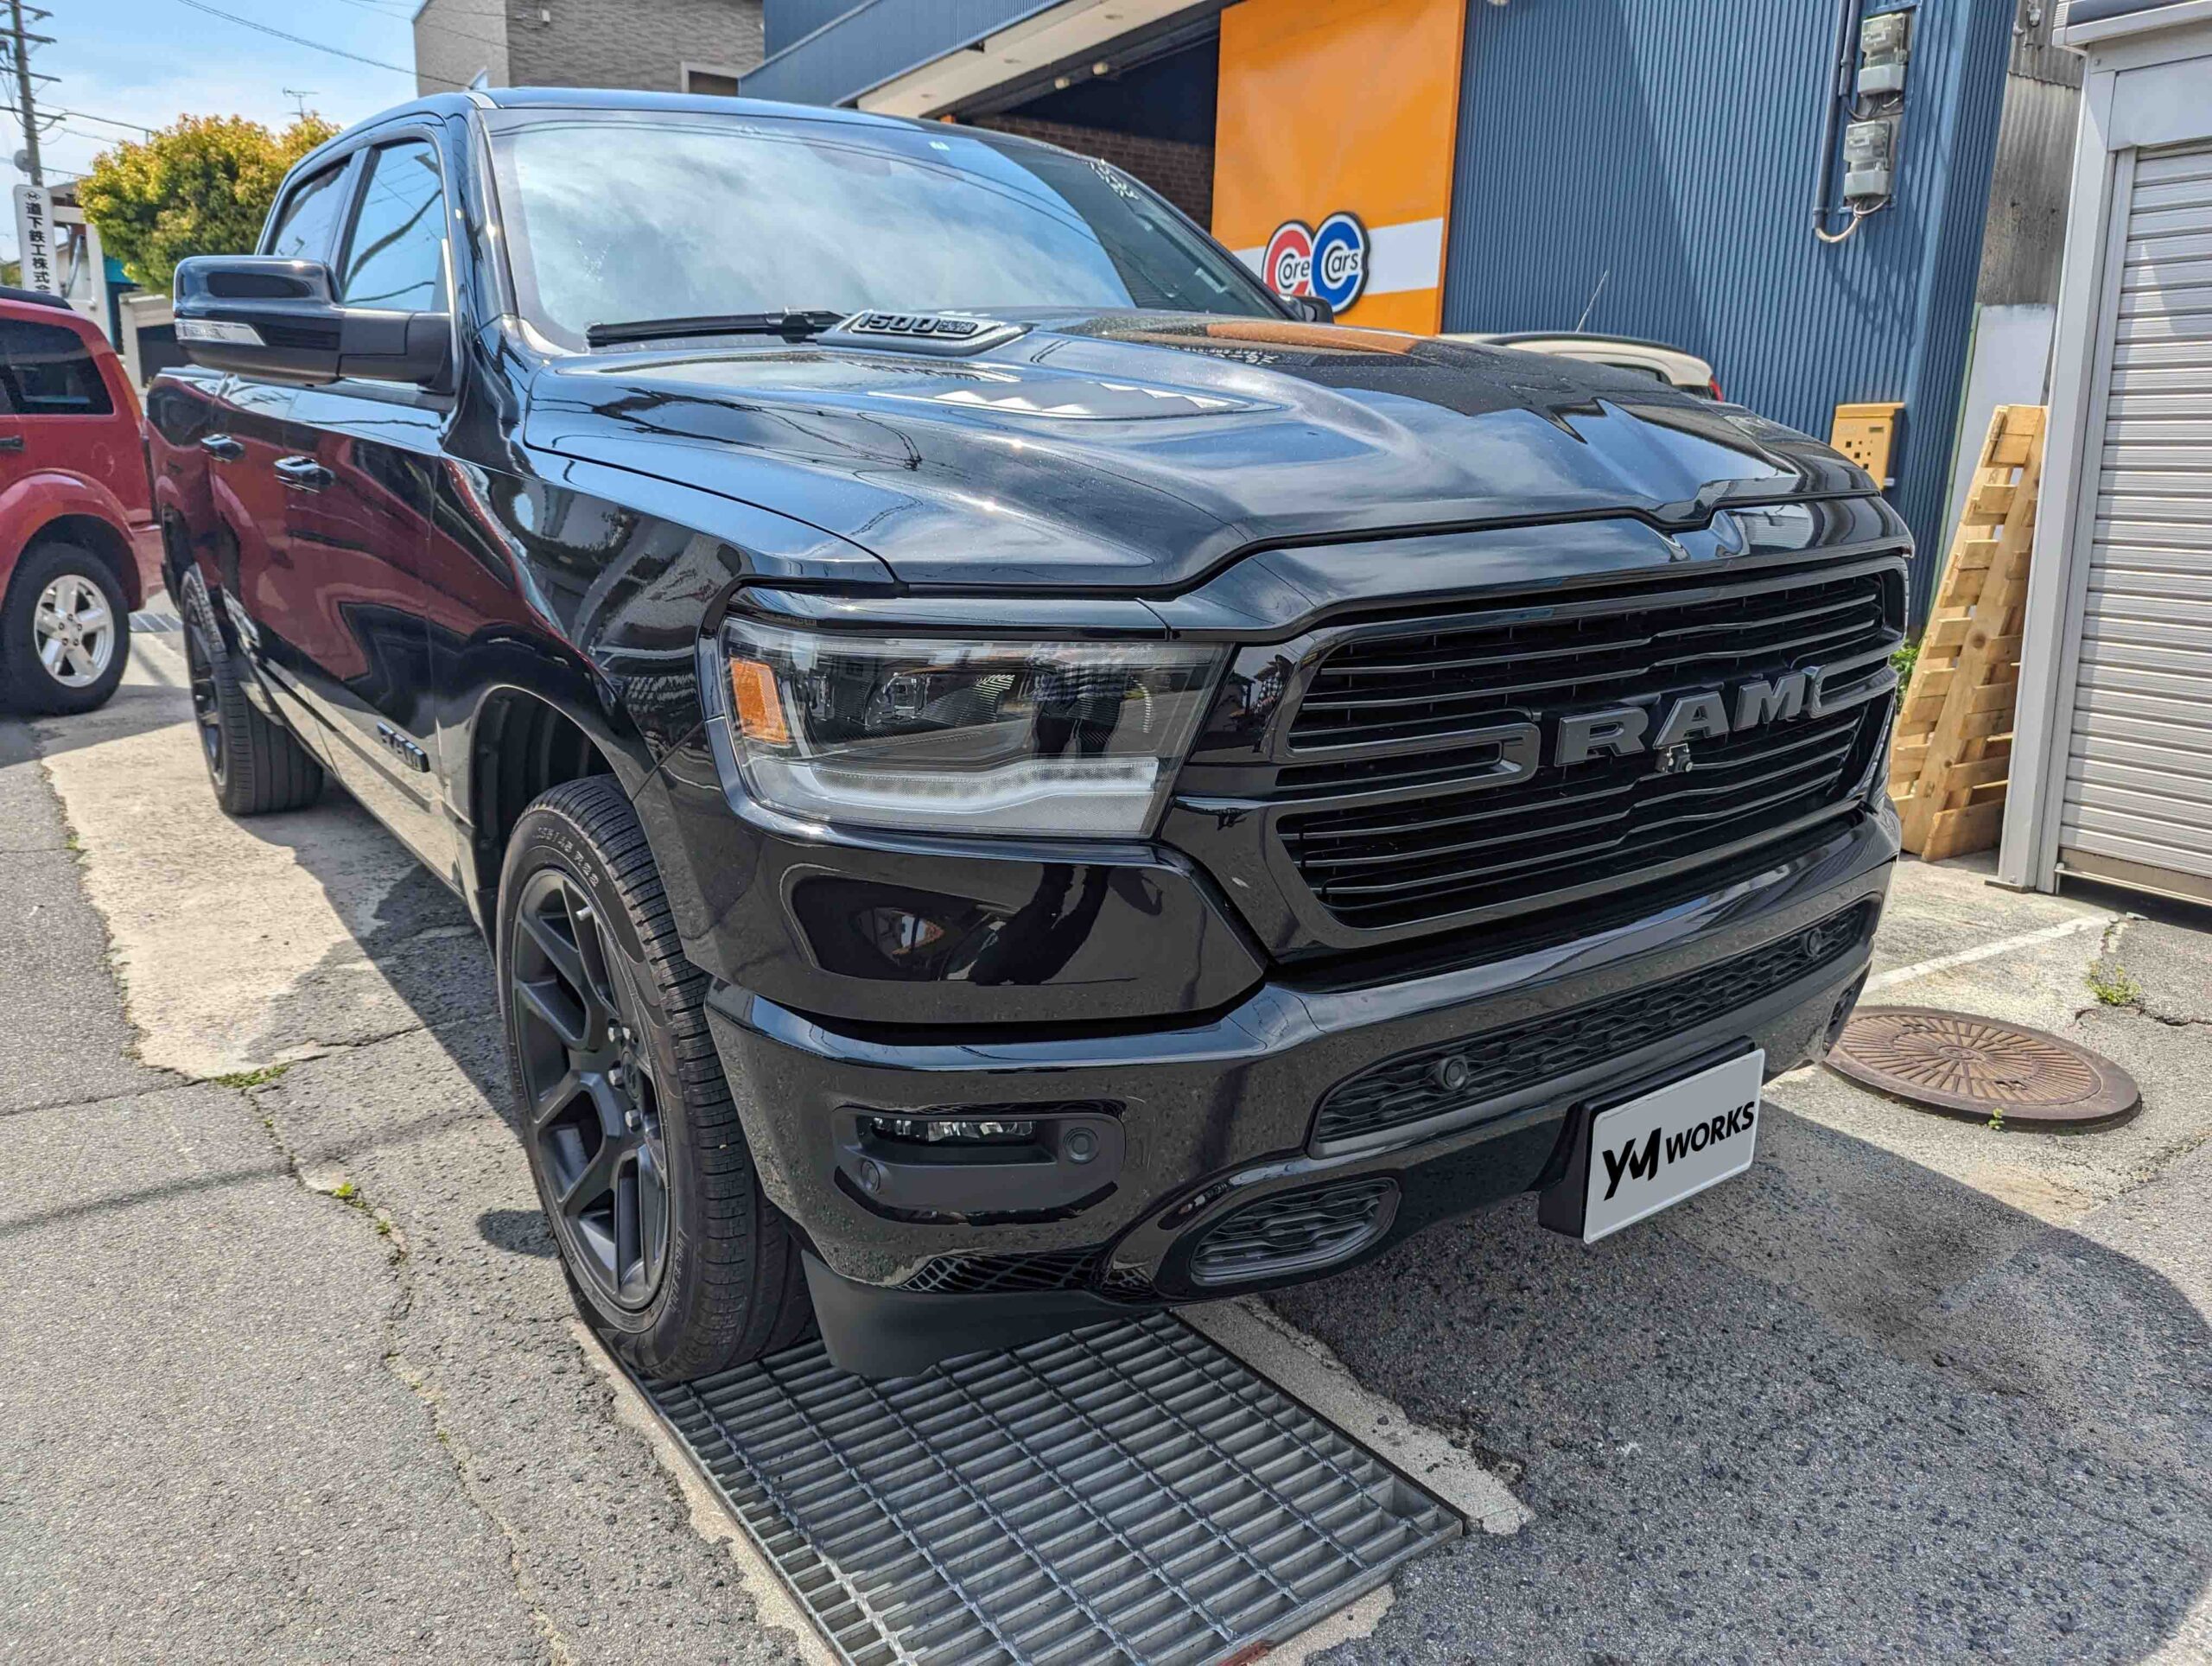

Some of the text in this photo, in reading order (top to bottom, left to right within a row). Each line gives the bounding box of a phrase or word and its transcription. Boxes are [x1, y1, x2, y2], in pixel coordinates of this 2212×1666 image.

[1278, 245, 1359, 289] Core Cars
[858, 312, 940, 333] 1500
[1554, 671, 1807, 767] RAM
[1602, 1101, 1756, 1202] YM WORKS
